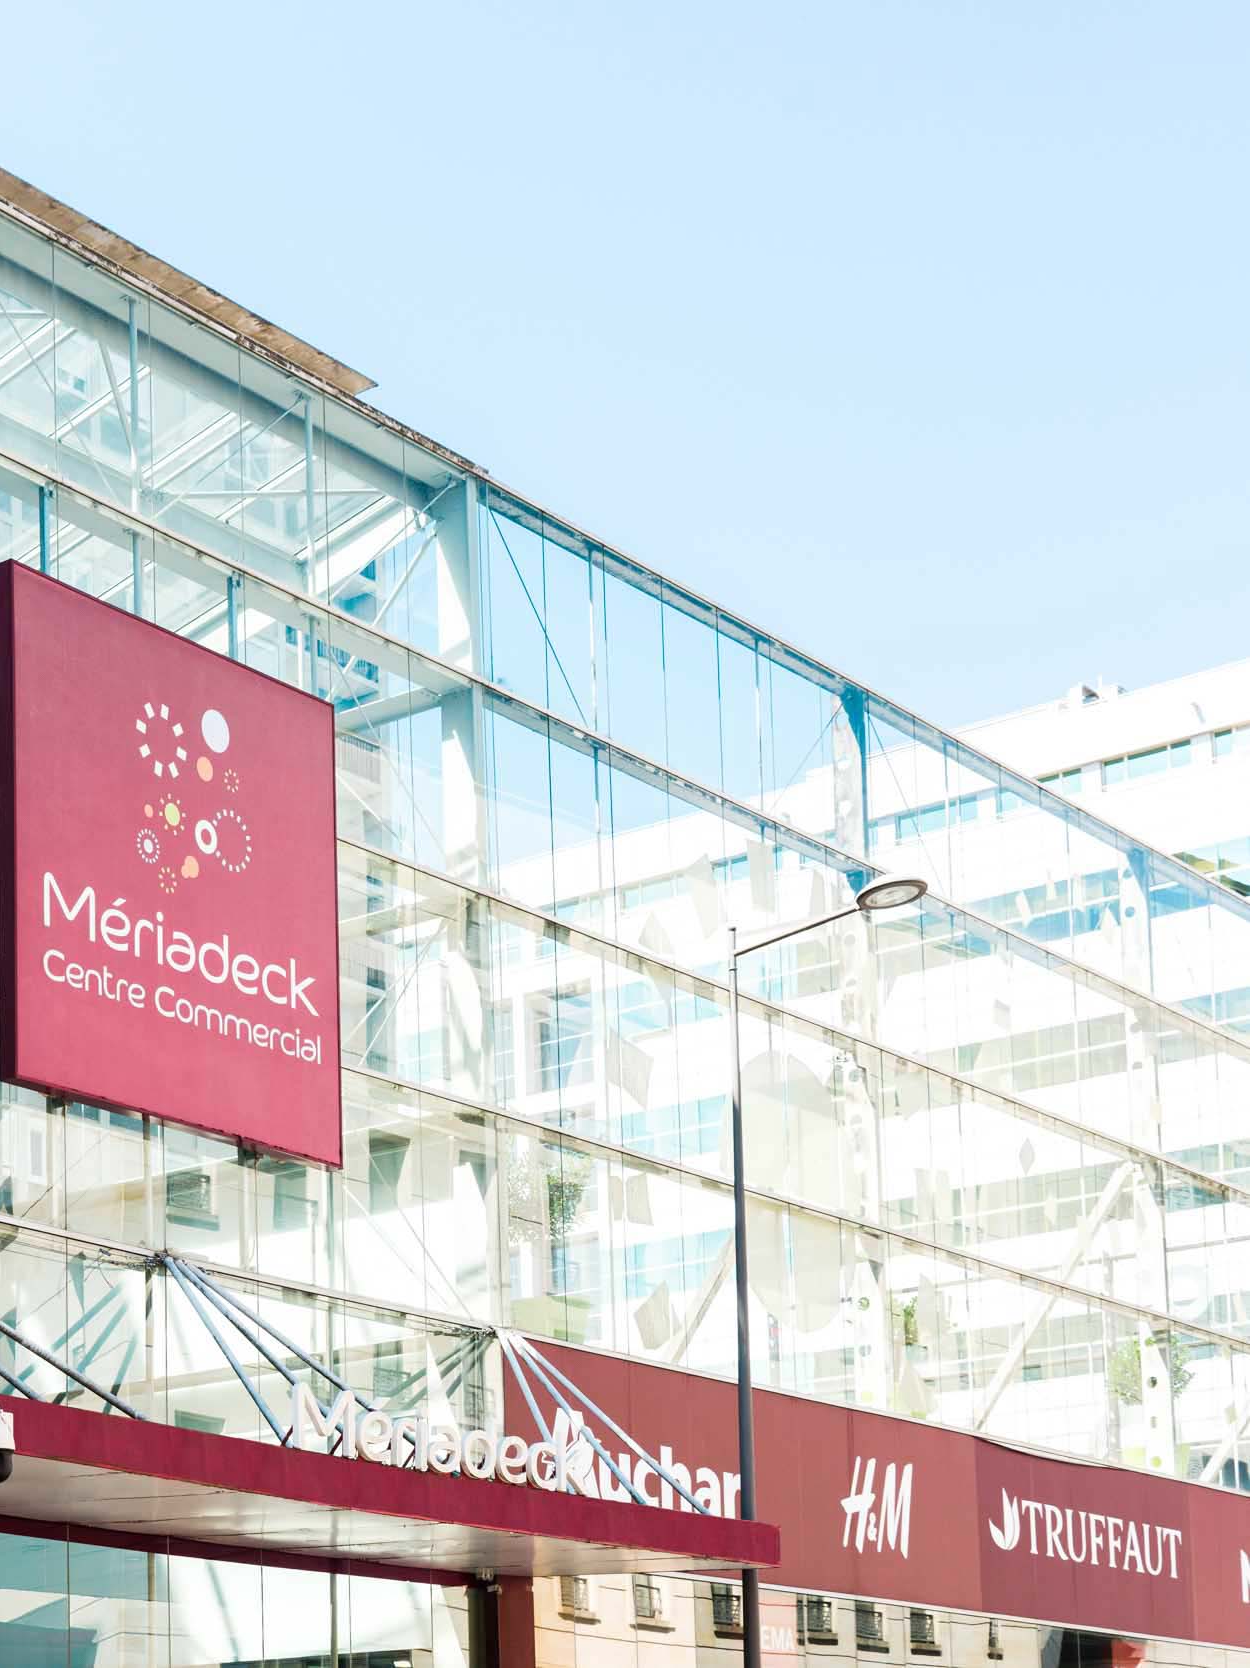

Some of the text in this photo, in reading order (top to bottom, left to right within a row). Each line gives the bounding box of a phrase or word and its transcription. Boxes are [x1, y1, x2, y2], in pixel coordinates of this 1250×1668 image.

[42, 871, 320, 1018] Mériadeck
[43, 948, 322, 1065] Centre Commercial
[291, 1383, 588, 1498] Mériadeck
[840, 1455, 913, 1560] H&M
[1021, 1499, 1183, 1579] TRUFFAUT
